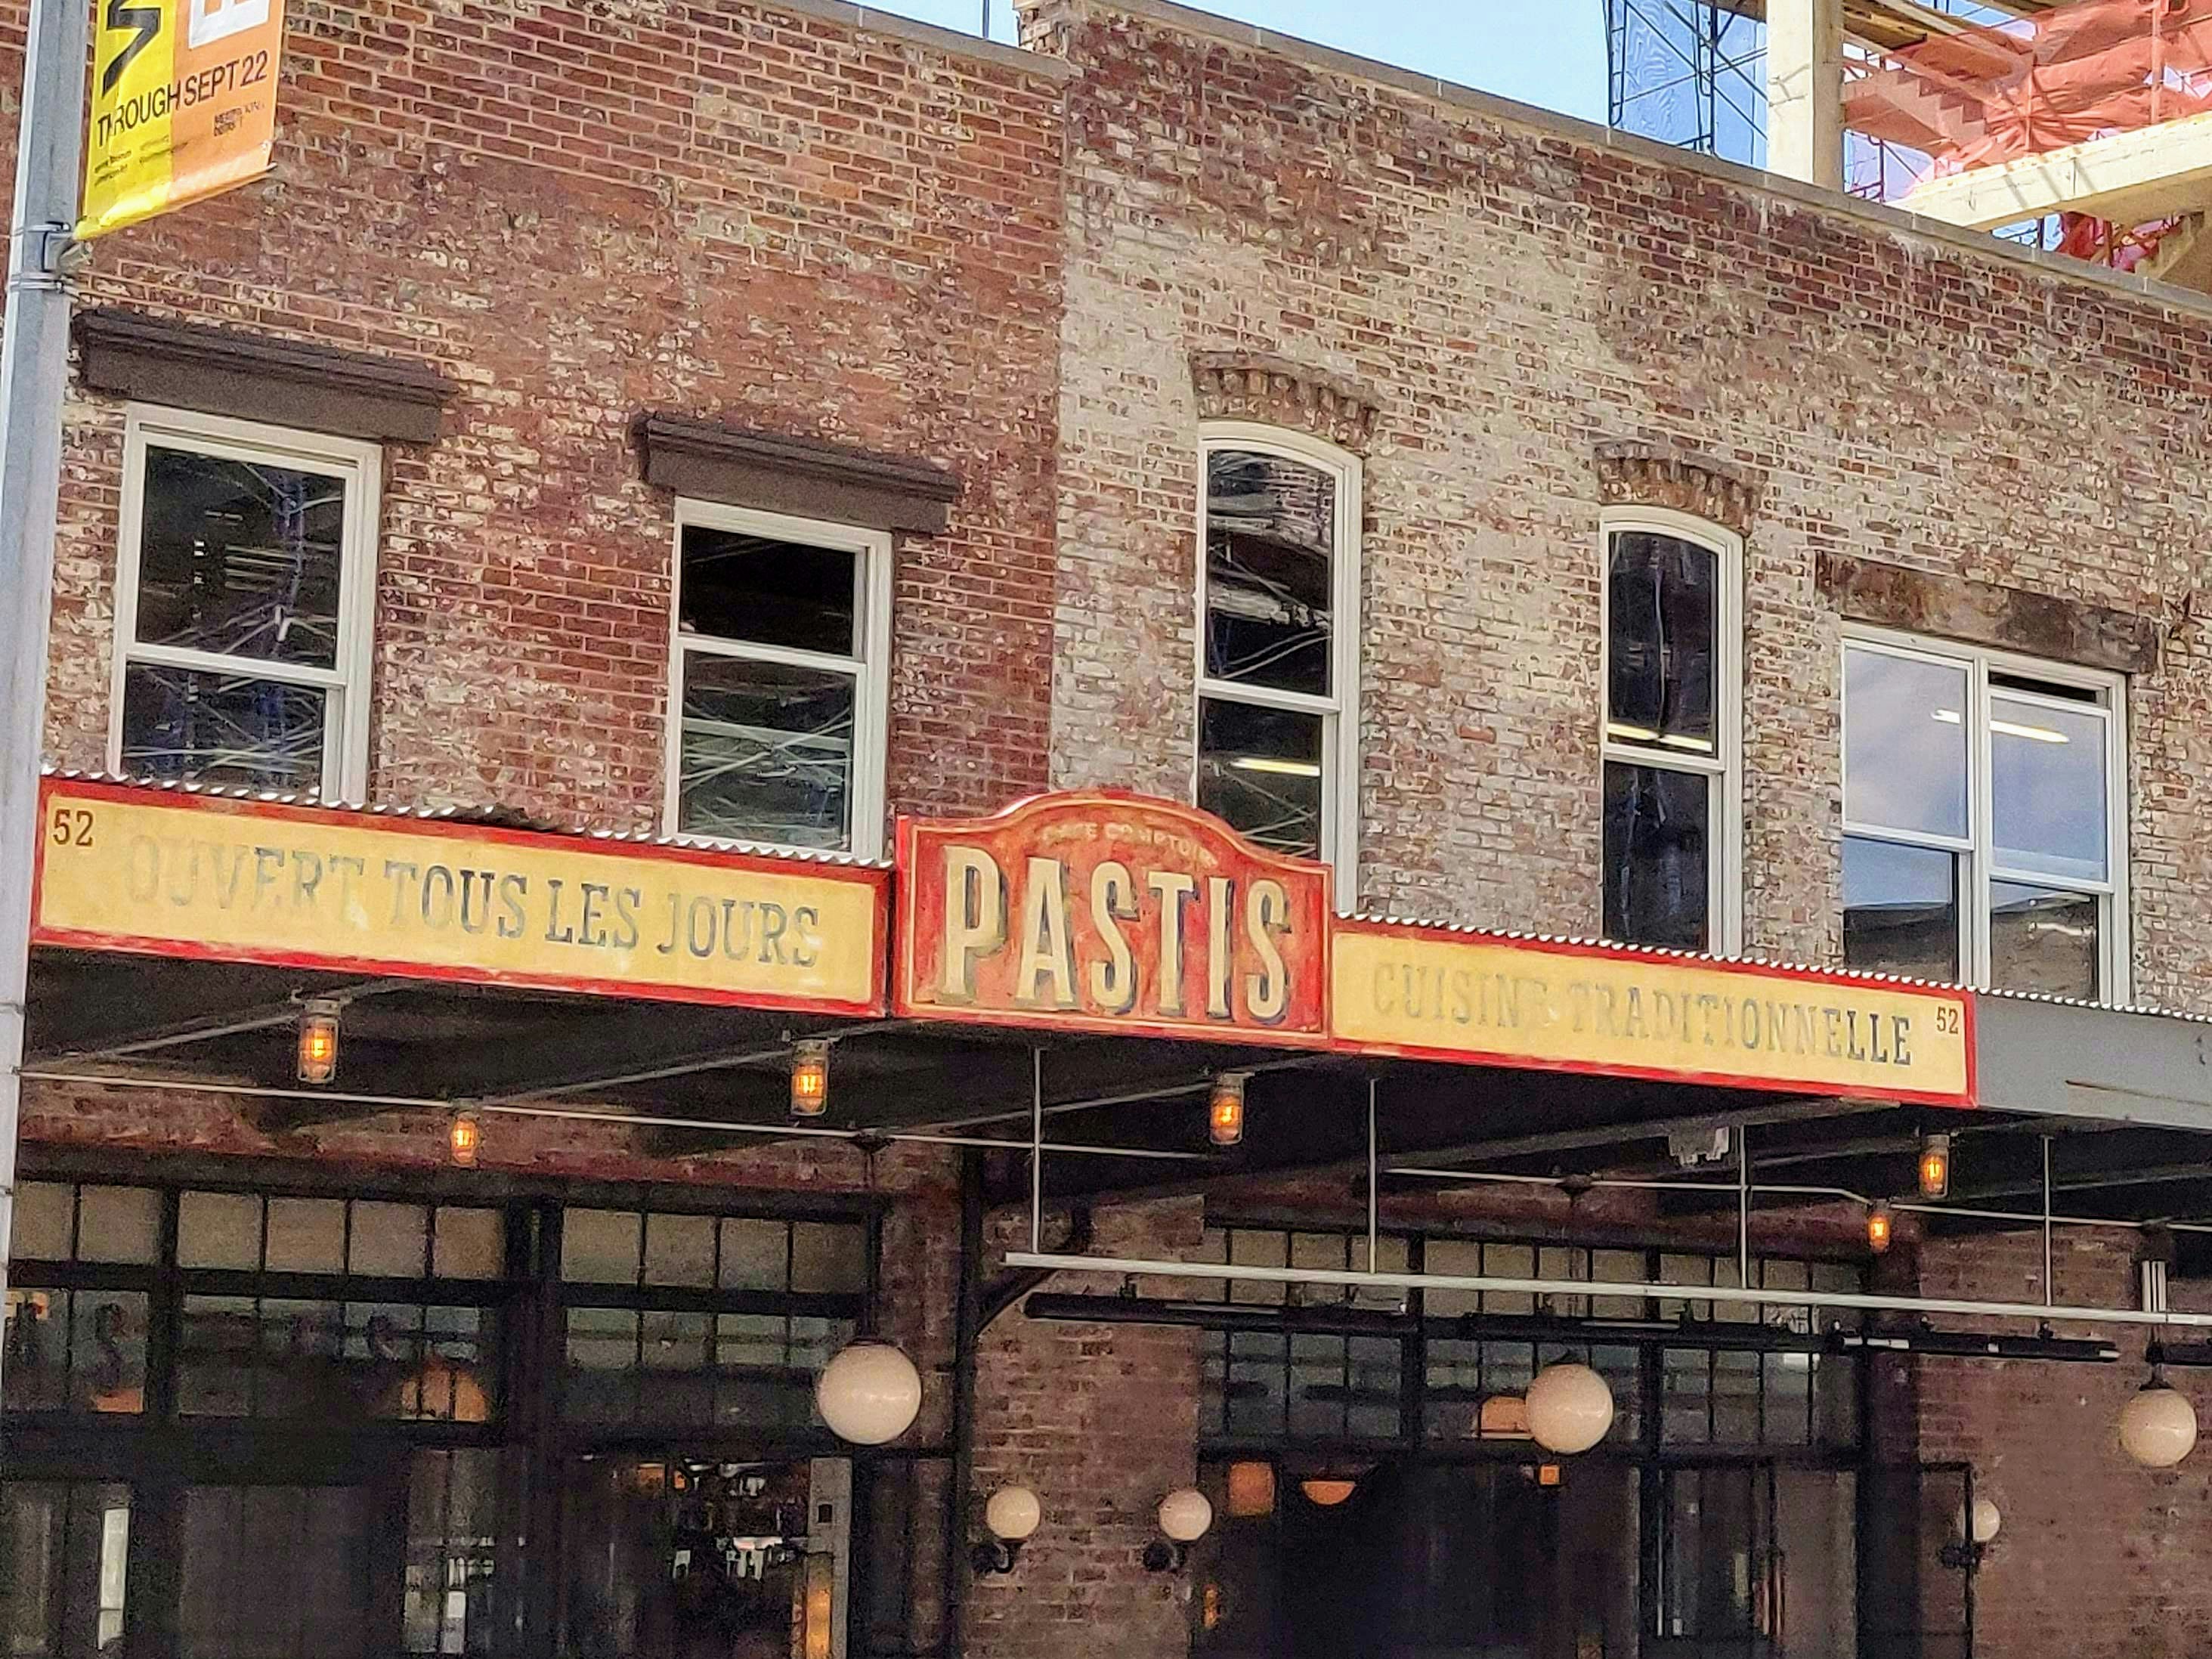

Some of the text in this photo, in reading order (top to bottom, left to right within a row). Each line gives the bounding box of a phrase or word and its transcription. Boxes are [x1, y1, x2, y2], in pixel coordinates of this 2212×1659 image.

[184, 60, 239, 107] SEPT
[240, 50, 268, 88] 22
[53, 809, 94, 847] 52
[128, 834, 819, 967] OUVERT TOUS LES JOURS
[936, 843, 1290, 1022] PASTIS
[1567, 980, 1911, 1066] TRADITIONNELLE
[1935, 1006, 1959, 1035] 52
